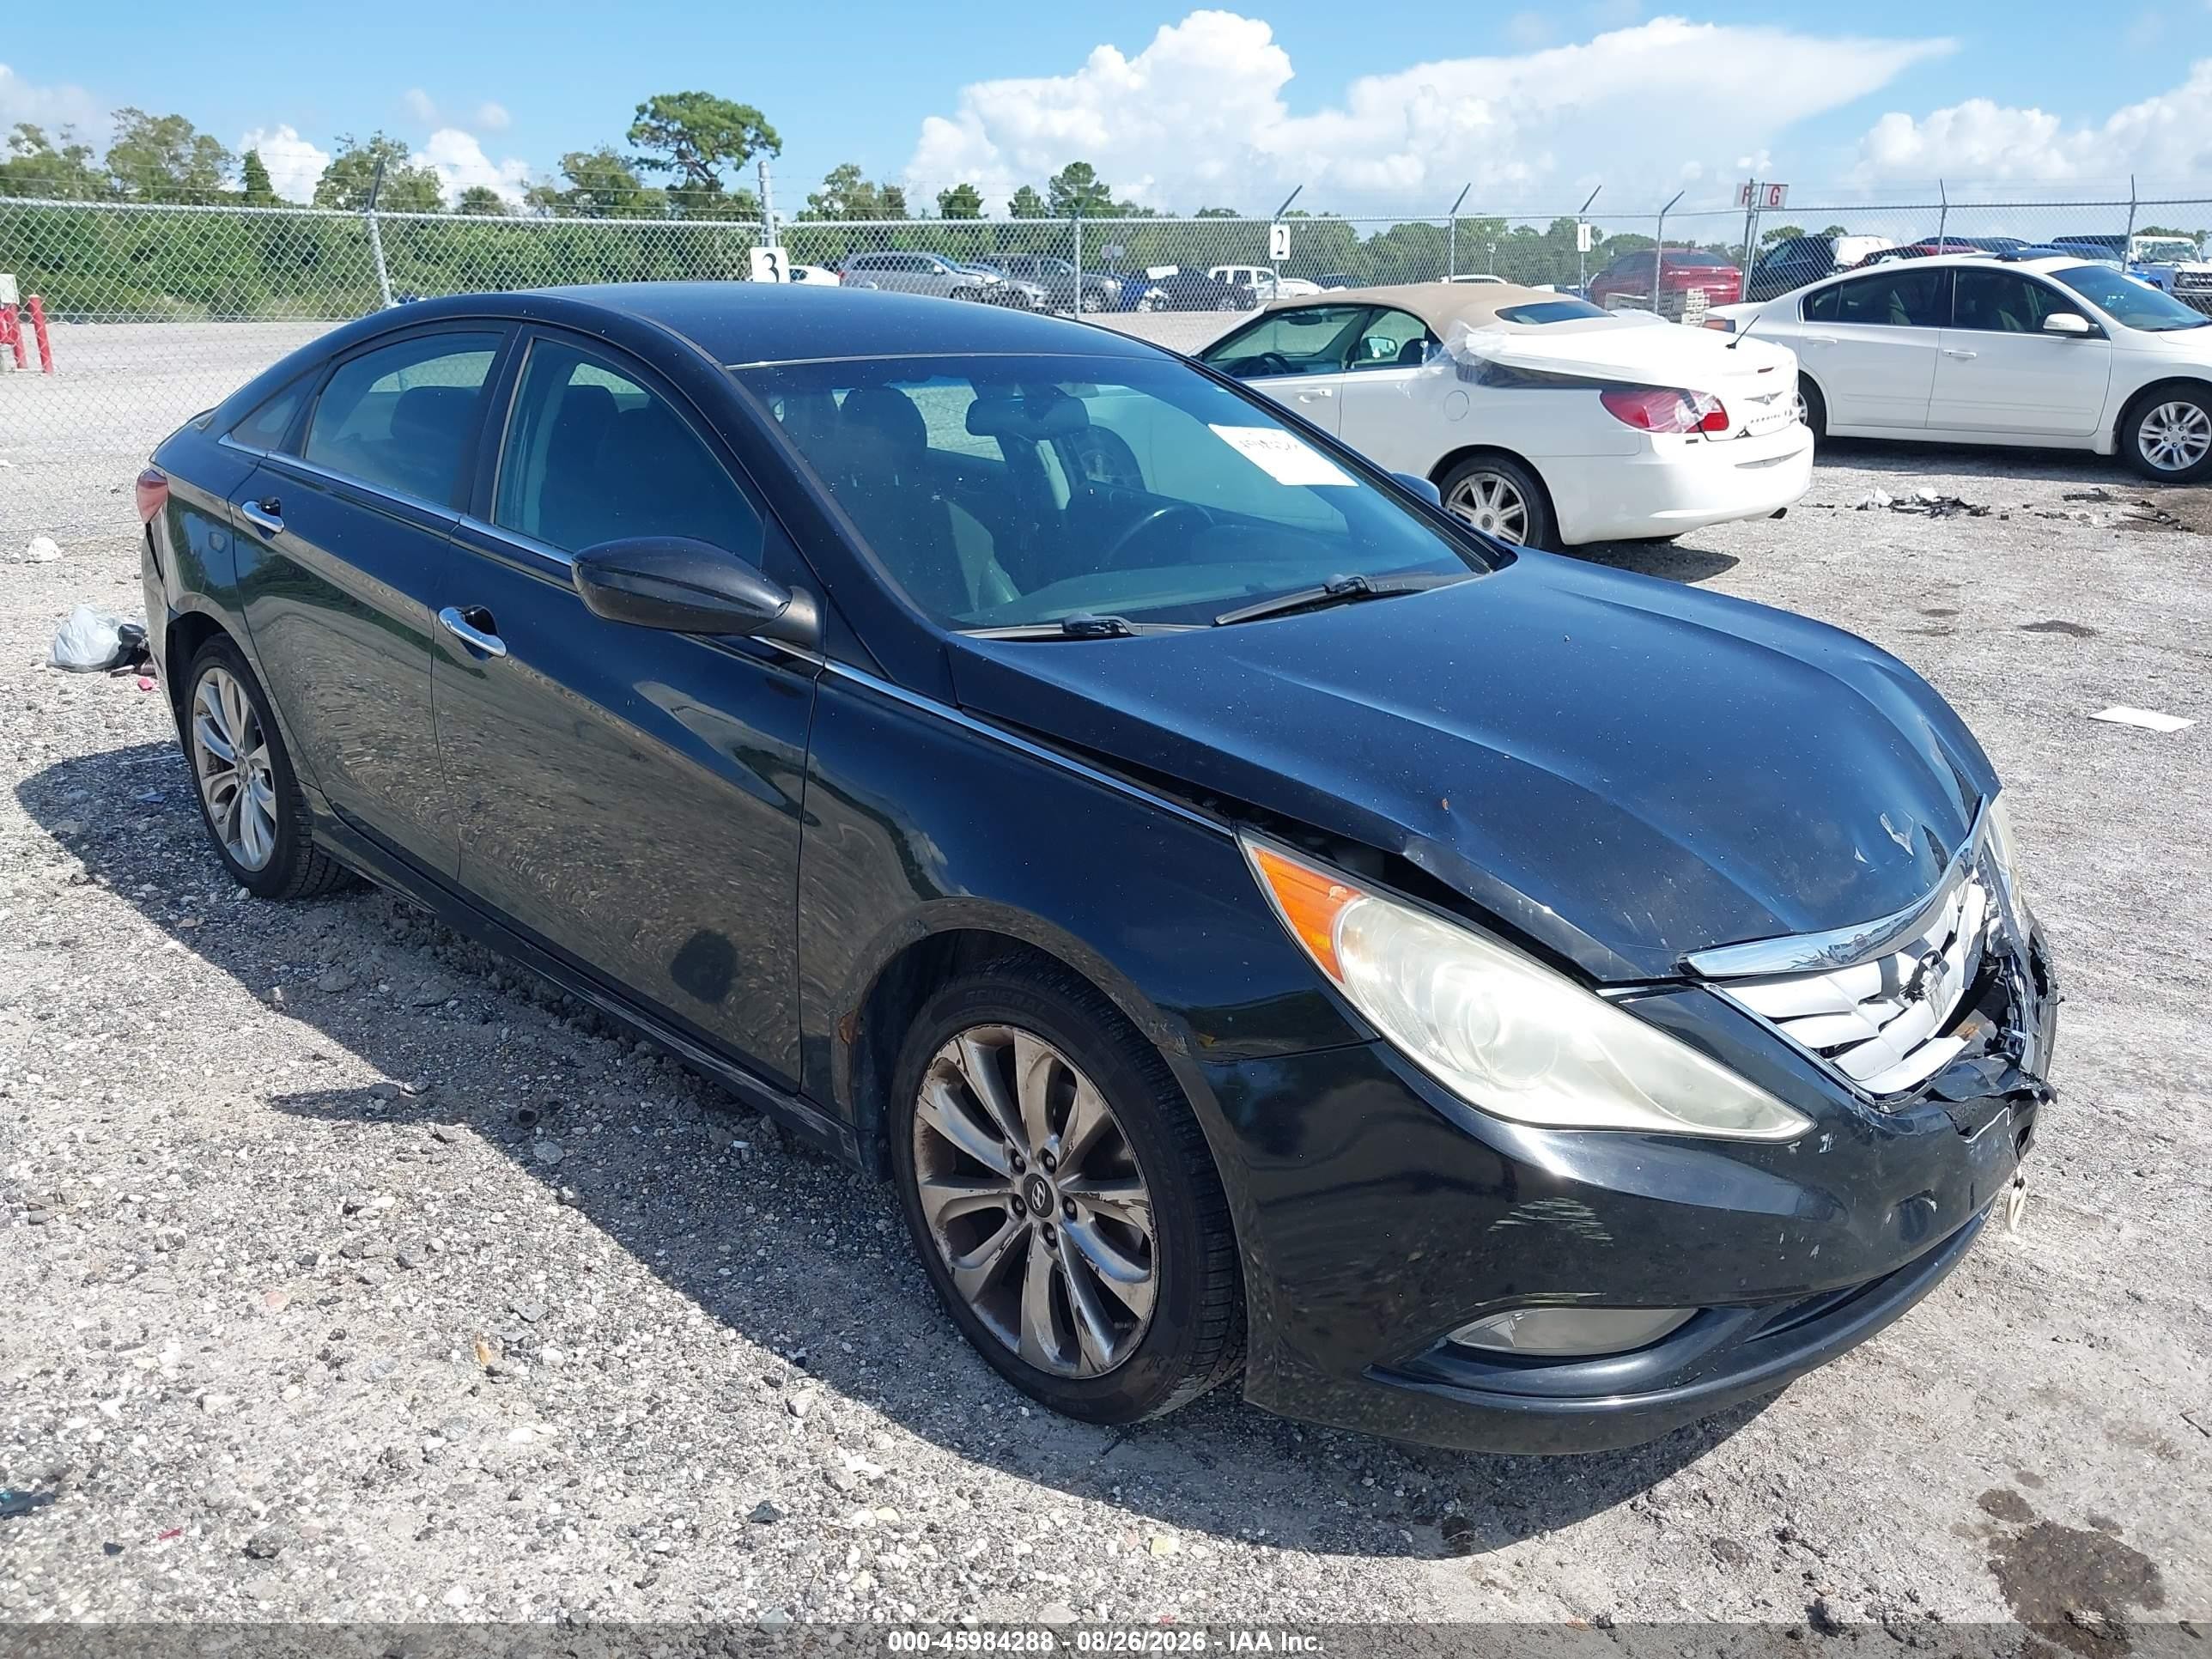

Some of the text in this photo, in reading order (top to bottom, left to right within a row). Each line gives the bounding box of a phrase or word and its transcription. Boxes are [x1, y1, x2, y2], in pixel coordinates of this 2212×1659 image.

[1770, 185, 1781, 206] G
[1276, 229, 1285, 256] 2
[763, 252, 780, 283] 3
